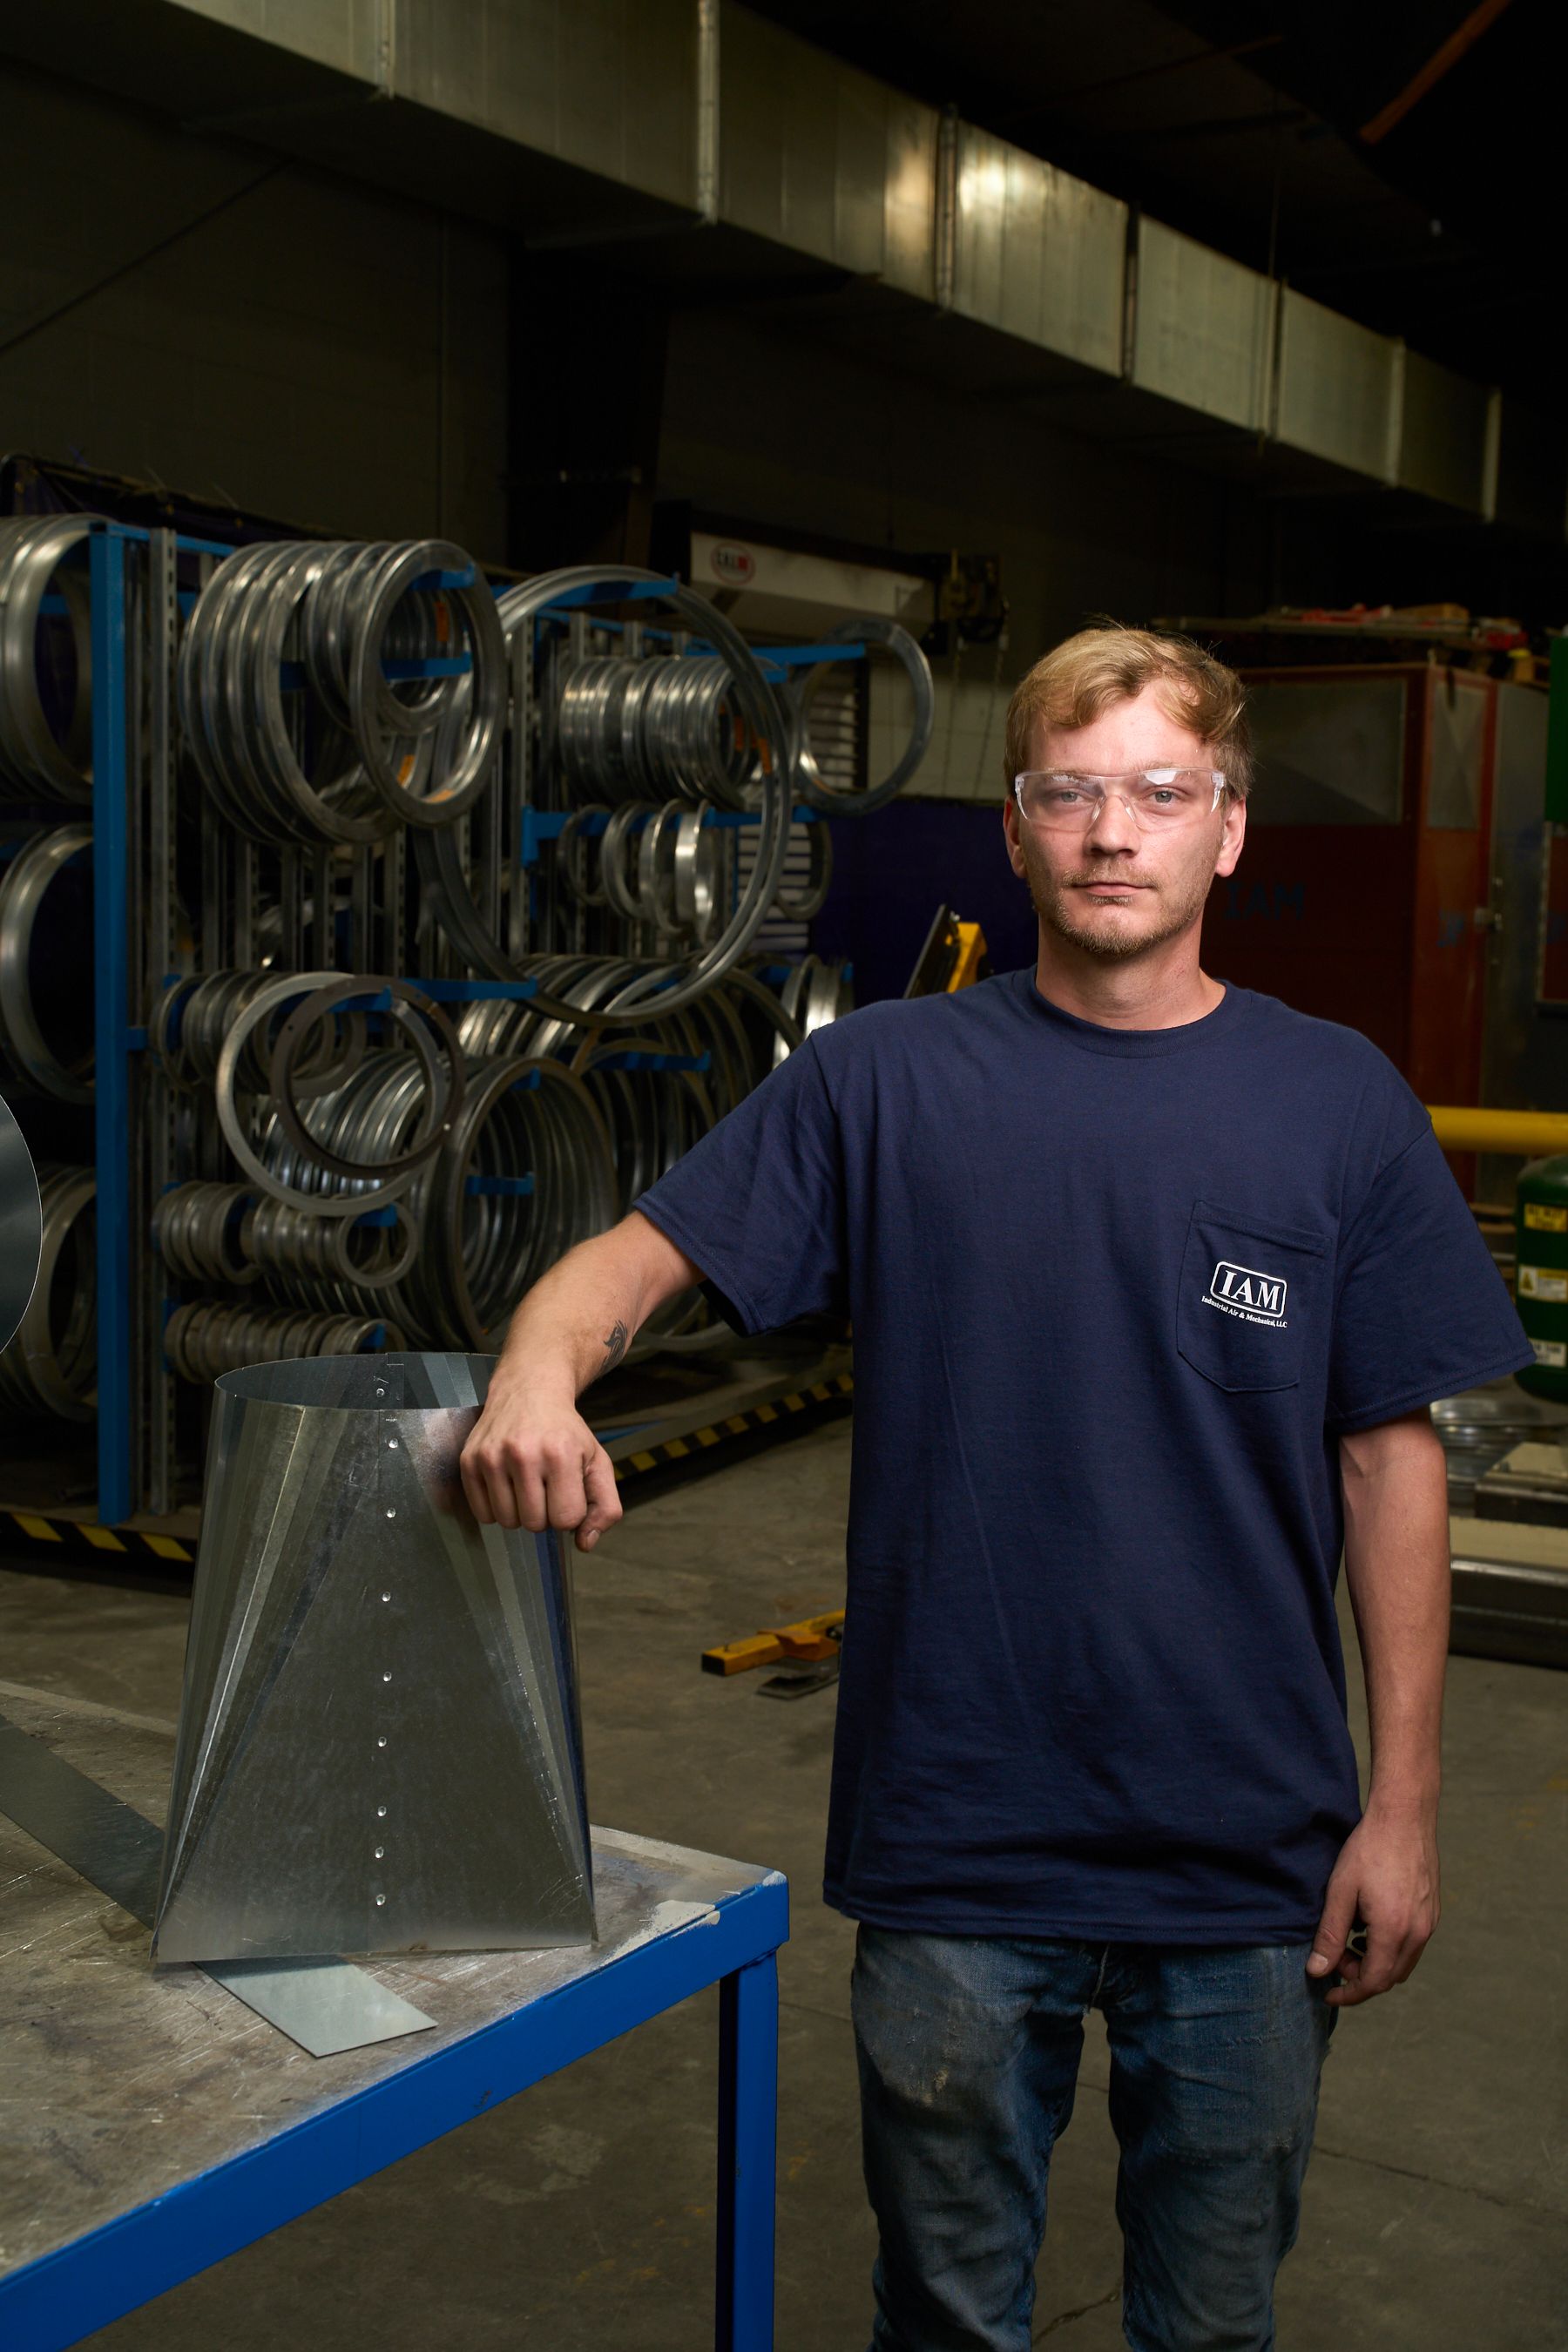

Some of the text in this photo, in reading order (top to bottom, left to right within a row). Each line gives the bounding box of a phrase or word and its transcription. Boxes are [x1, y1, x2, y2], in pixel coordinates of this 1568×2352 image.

[1225, 882, 1305, 920] IAM
[1218, 1270, 1281, 1311] IAM
[1201, 1295, 1228, 1313] Industrial
[1276, 1320, 1288, 1328] LLC
